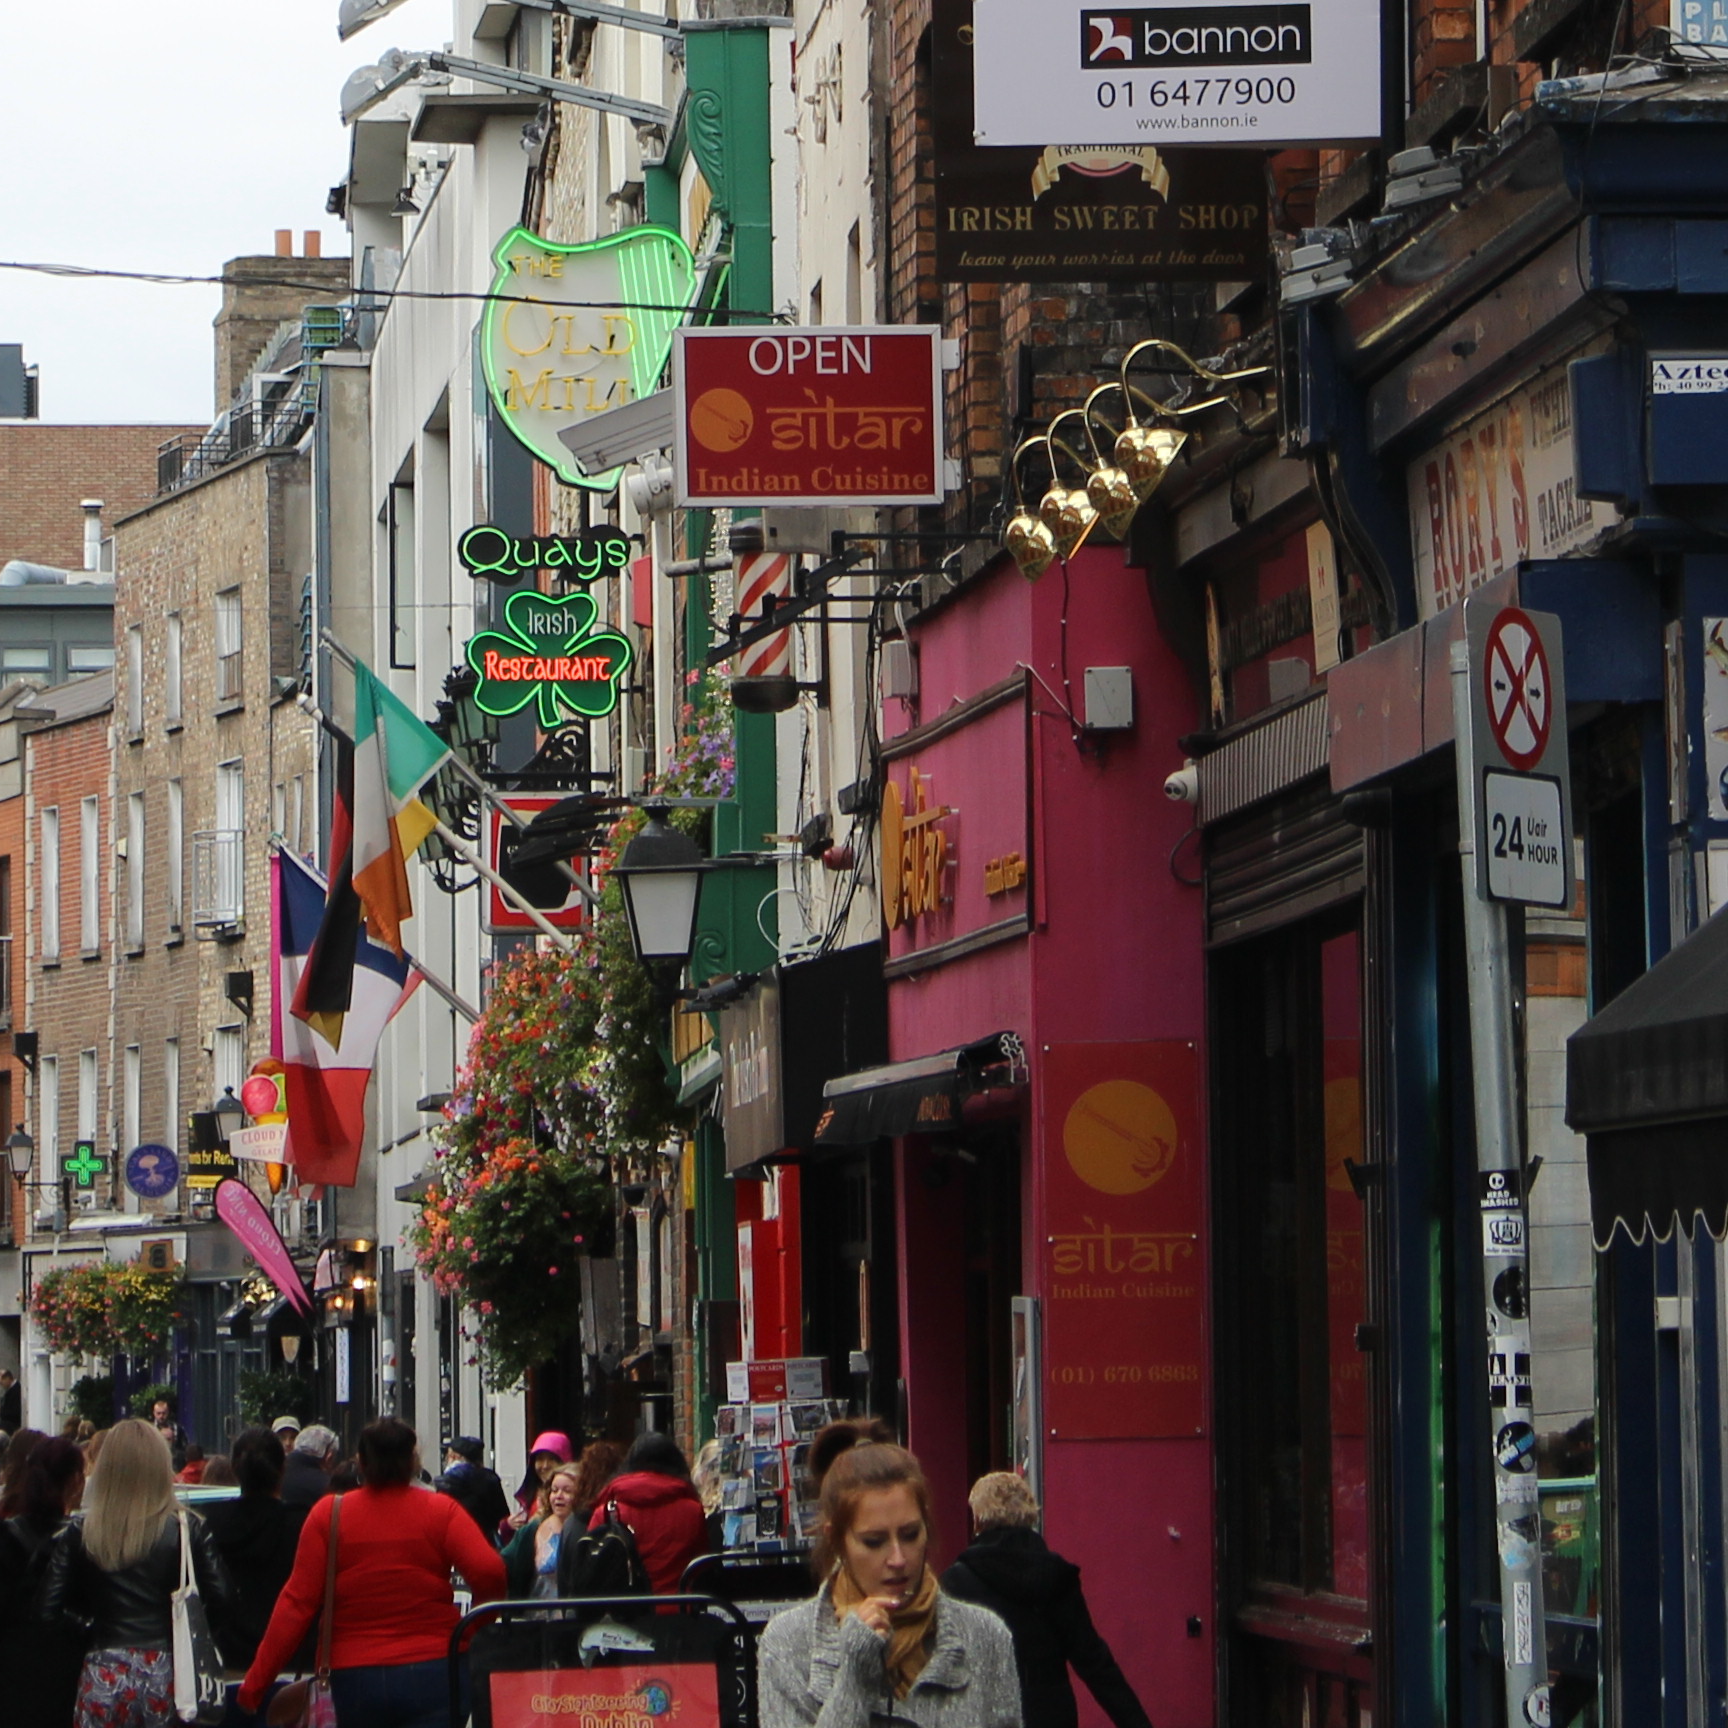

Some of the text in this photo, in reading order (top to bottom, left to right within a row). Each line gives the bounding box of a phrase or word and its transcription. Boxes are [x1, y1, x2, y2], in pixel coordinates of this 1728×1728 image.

[1143, 21, 1302, 56] bannon
[1096, 77, 1297, 109] 01 6477900
[1135, 113, 1259, 131] www.bannon.ie
[948, 204, 1260, 232] IRISH SWEET SHOP
[512, 255, 564, 278] THE
[1012, 253, 1057, 270] your
[1063, 250, 1135, 266] worries
[1141, 250, 1162, 266] at
[1168, 250, 1196, 266] the
[1203, 249, 1246, 266] door
[503, 295, 638, 358] OLD
[748, 335, 872, 377] OPEN
[1676, 381, 1692, 390] 40
[1697, 381, 1712, 389] 99
[767, 386, 926, 452] sitar
[695, 464, 930, 494] Indian Cuisine
[460, 526, 631, 580] Quays
[1492, 812, 1525, 862] 24
[1527, 816, 1548, 839] Uair
[1527, 843, 1559, 867] HOUR
[241, 1129, 276, 1145] CLOUD
[1048, 1215, 1198, 1274] sitar
[1052, 1282, 1196, 1299] Indian Cuisine
[1051, 1365, 1095, 1385] (01)
[1104, 1365, 1142, 1383] 670
